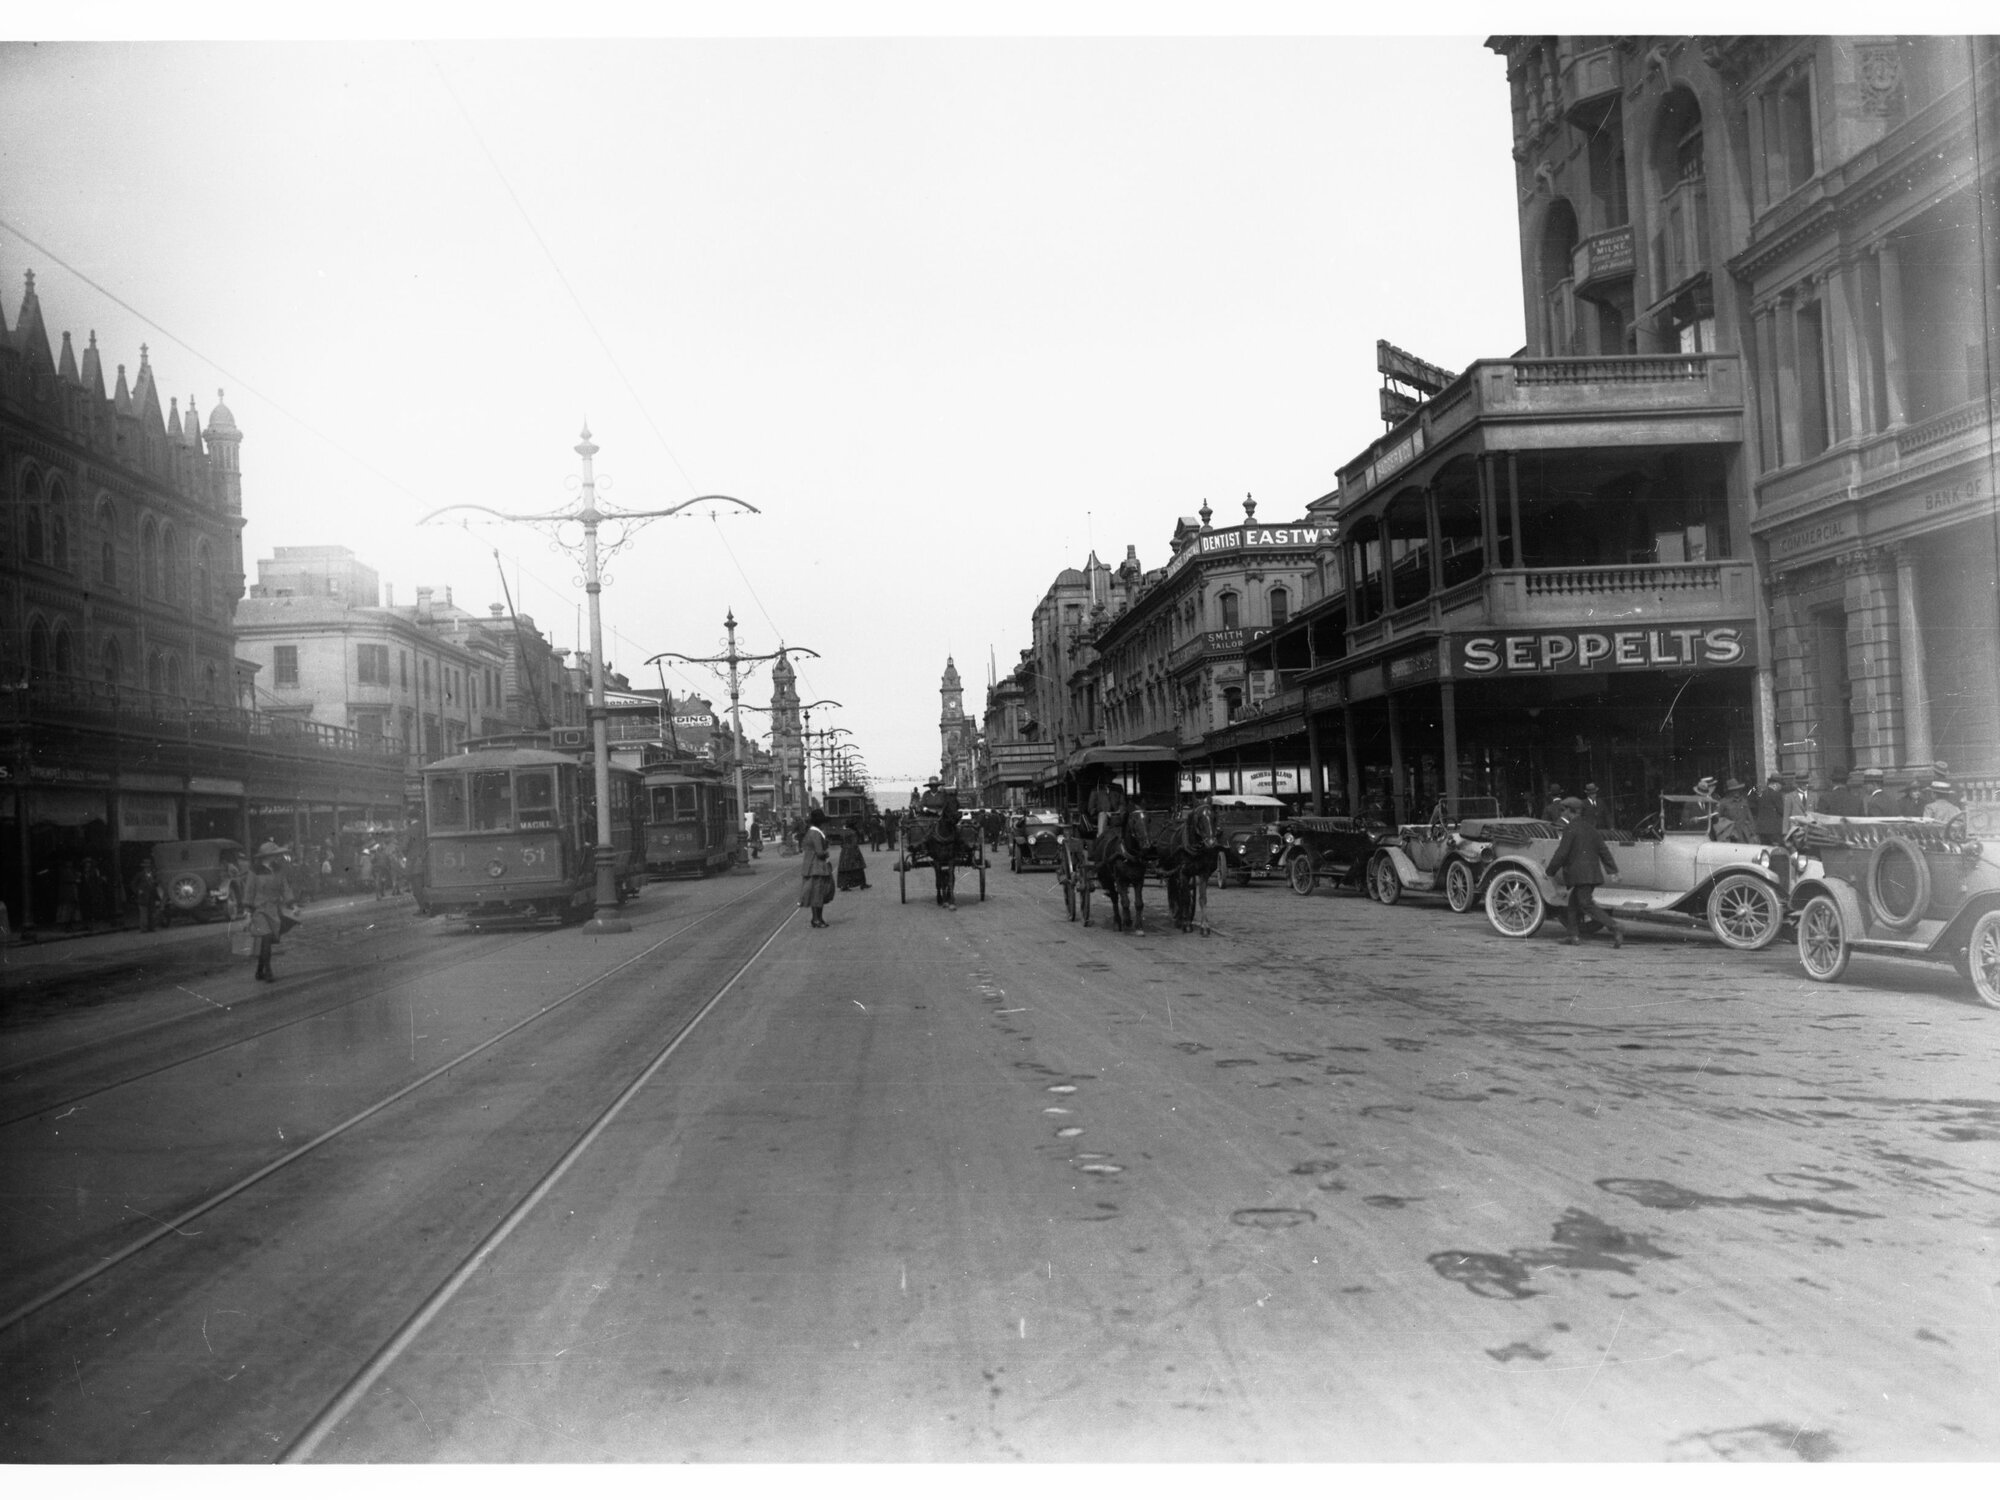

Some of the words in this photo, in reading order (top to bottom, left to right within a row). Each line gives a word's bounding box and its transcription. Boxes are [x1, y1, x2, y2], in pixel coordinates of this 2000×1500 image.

[1781, 522, 1844, 553] COMMERCIAL
[1925, 488, 1960, 511] BANK
[1966, 478, 1982, 497] OF
[1202, 531, 1241, 552] DENTIST
[1208, 630, 1243, 643] SMITH
[1211, 641, 1244, 651] TAILOR
[1464, 628, 1744, 675] SEPPELTS
[520, 820, 551, 830] MAGILL
[444, 851, 466, 868] 51
[522, 848, 546, 864] 51
